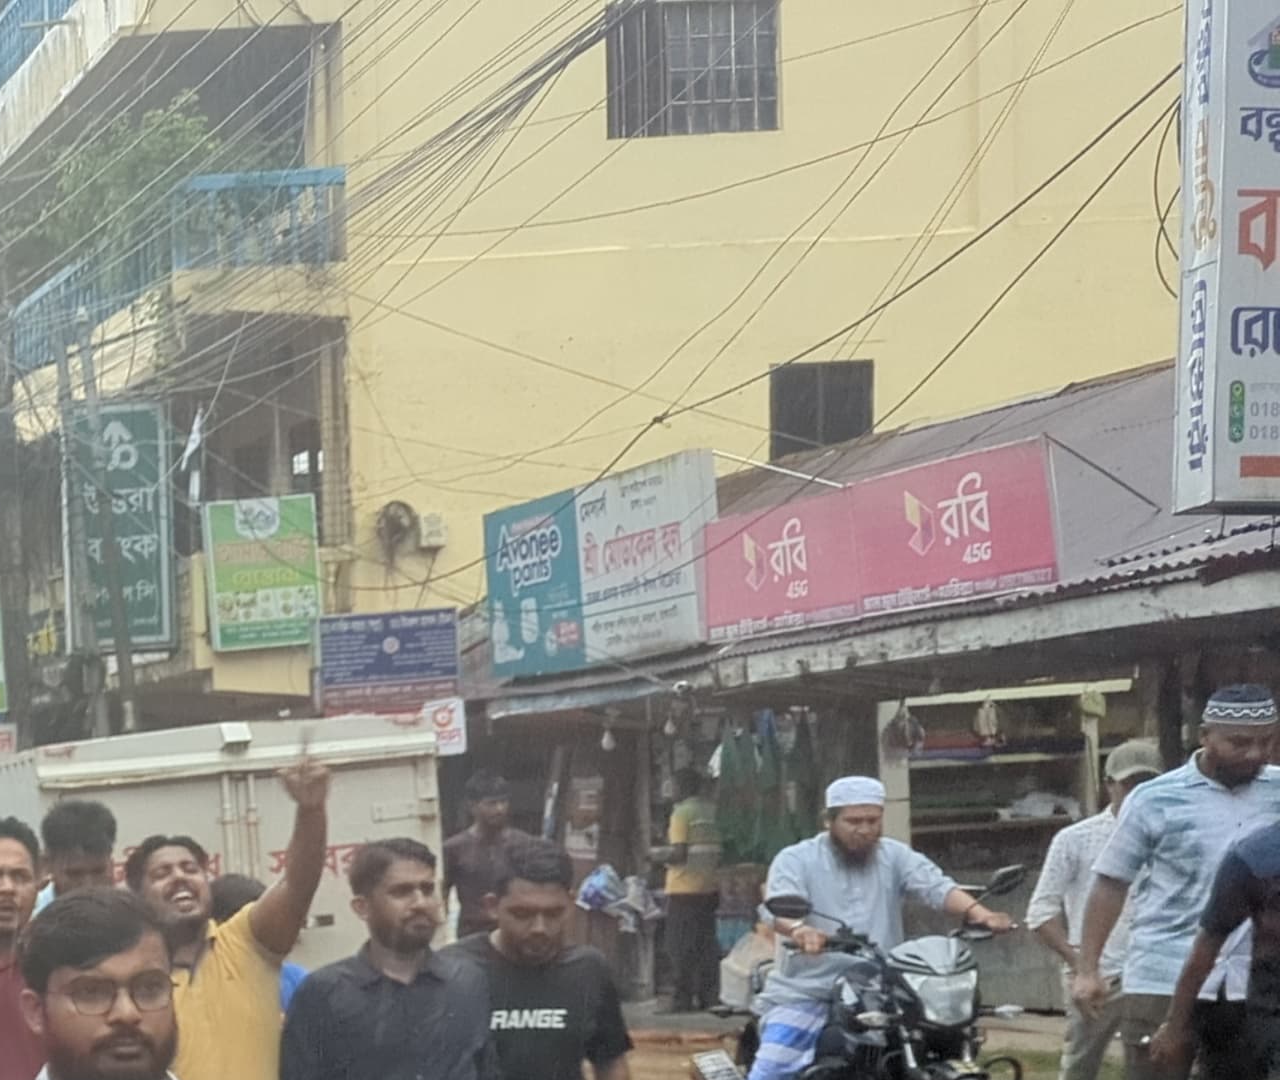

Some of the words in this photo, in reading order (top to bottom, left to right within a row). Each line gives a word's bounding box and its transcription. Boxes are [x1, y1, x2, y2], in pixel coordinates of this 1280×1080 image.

[1238, 189, 1280, 272] ব
[1251, 401, 1280, 417] 018
[1250, 425, 1280, 440] 018
[938, 472, 990, 546] রবি
[498, 526, 561, 570] Avonee
[768, 518, 807, 582] রবি
[512, 558, 551, 596] pants
